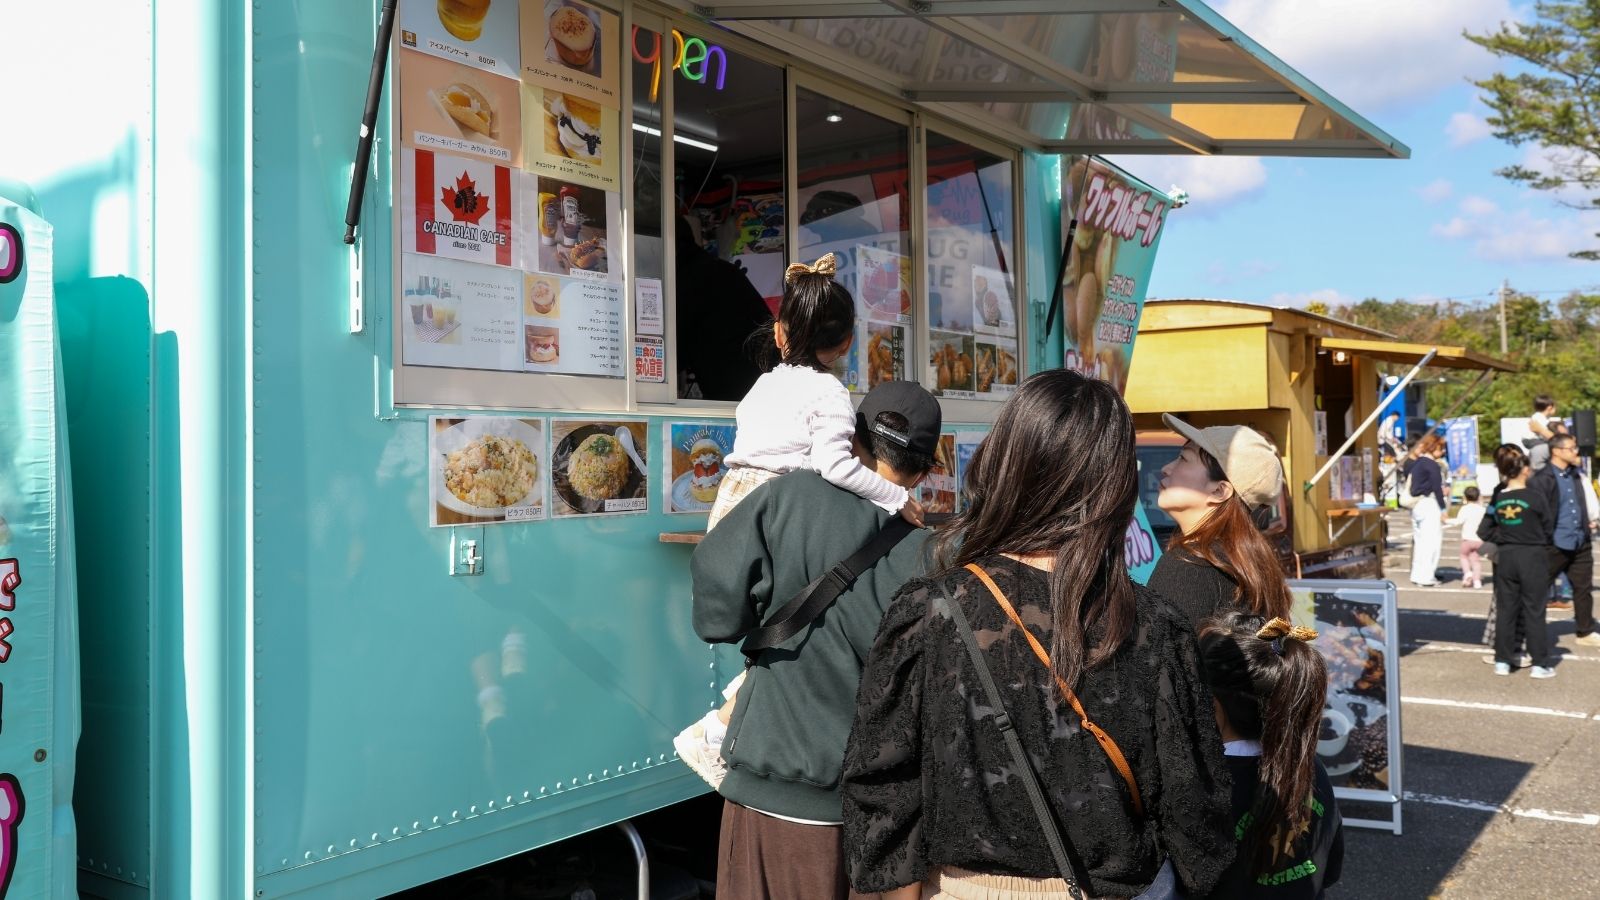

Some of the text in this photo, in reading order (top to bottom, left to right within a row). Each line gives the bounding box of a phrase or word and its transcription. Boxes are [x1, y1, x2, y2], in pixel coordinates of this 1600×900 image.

[429, 40, 470, 59] アイスパンケーキ
[478, 55, 496, 67] 800円
[419, 134, 508, 159] パンケーキバーガー みかん 850円
[1084, 173, 1166, 247] ワッフルボール
[423, 220, 507, 246] CANADIAN CAFE
[452, 241, 467, 250] since
[507, 507, 542, 517] ピラフ 850円
[606, 500, 631, 509] チャーハン
